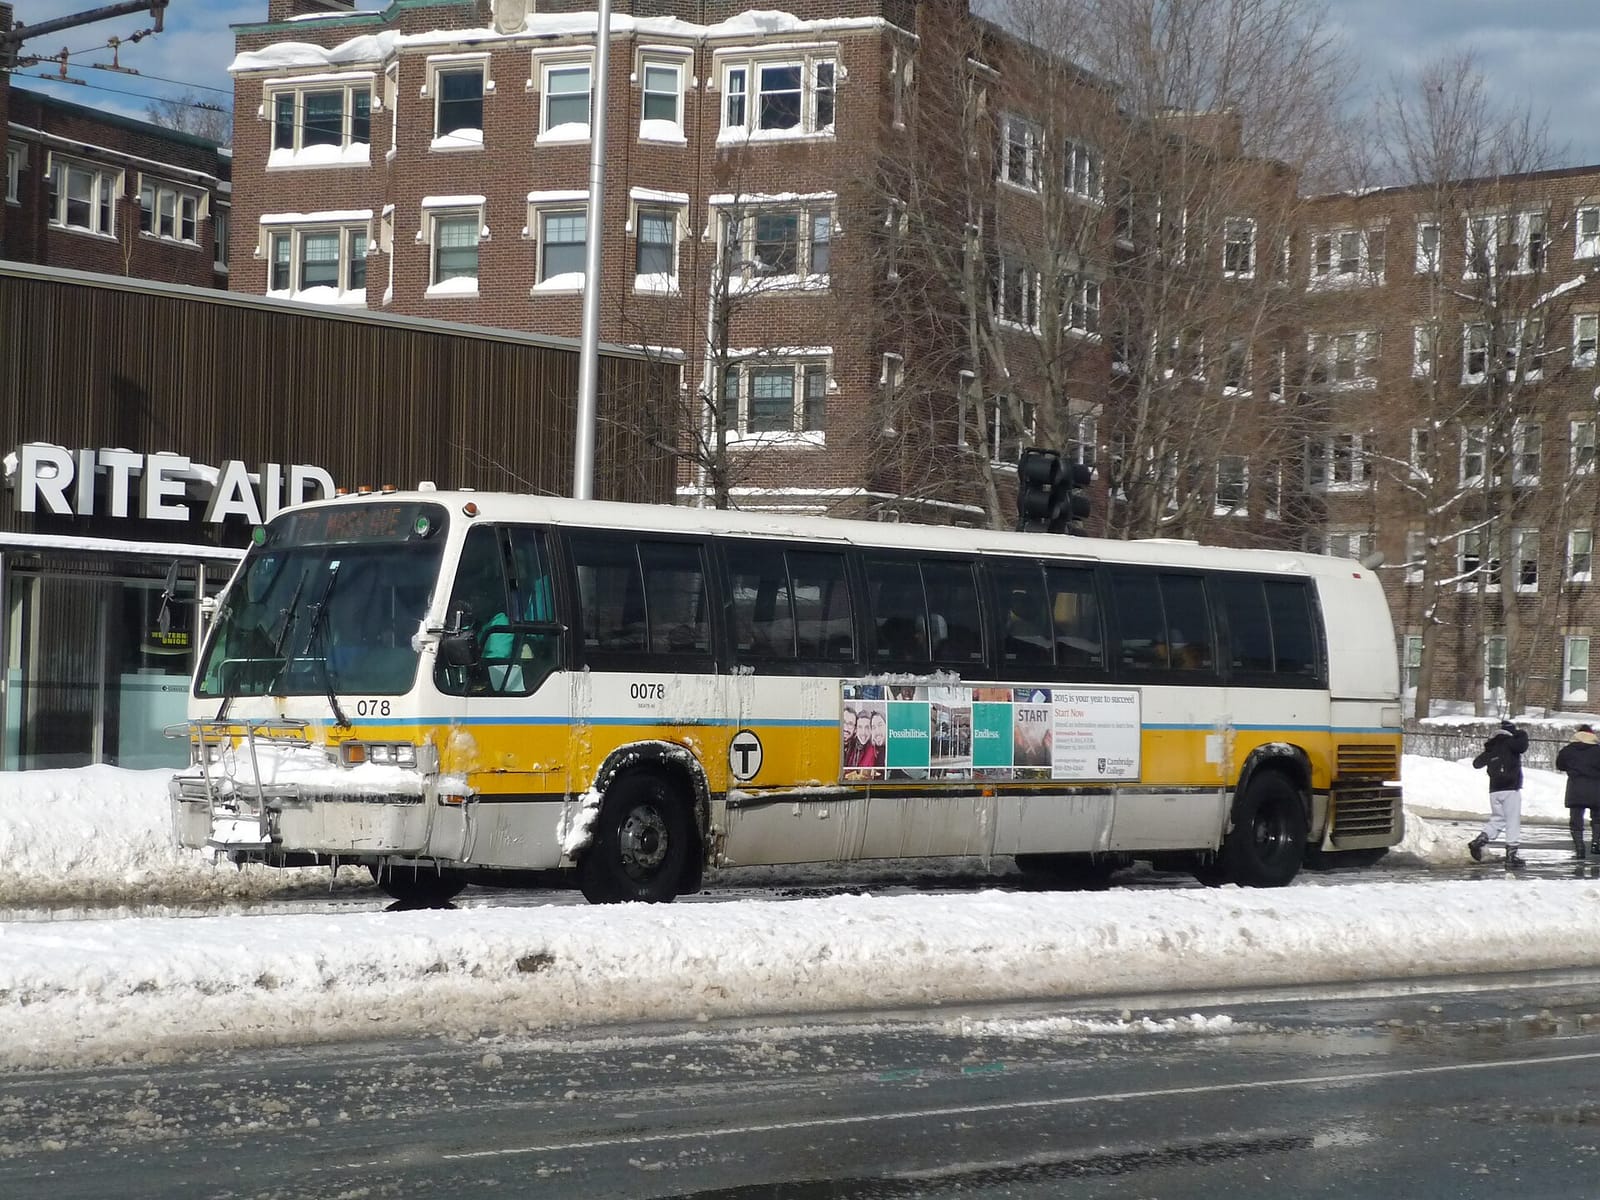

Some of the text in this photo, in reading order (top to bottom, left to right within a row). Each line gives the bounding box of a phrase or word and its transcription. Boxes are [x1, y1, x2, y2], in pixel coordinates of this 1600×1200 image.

[20, 443, 191, 521] RITE
[209, 460, 336, 524] AID
[151, 631, 188, 639] WETERN
[630, 683, 665, 699] 0078
[1054, 694, 1068, 703] 2015
[1075, 695, 1089, 704] your
[1090, 695, 1103, 704] year
[1104, 695, 1110, 703] to
[1111, 694, 1135, 704] succeed
[357, 700, 391, 716] 078
[1054, 708, 1084, 717] Start Now
[1018, 709, 1048, 722] START
[889, 728, 928, 738] Possibilities.
[974, 728, 1000, 738] Endless.
[733, 743, 758, 774] T
[1106, 757, 1135, 767] Cambridge
[1106, 766, 1126, 776] College
